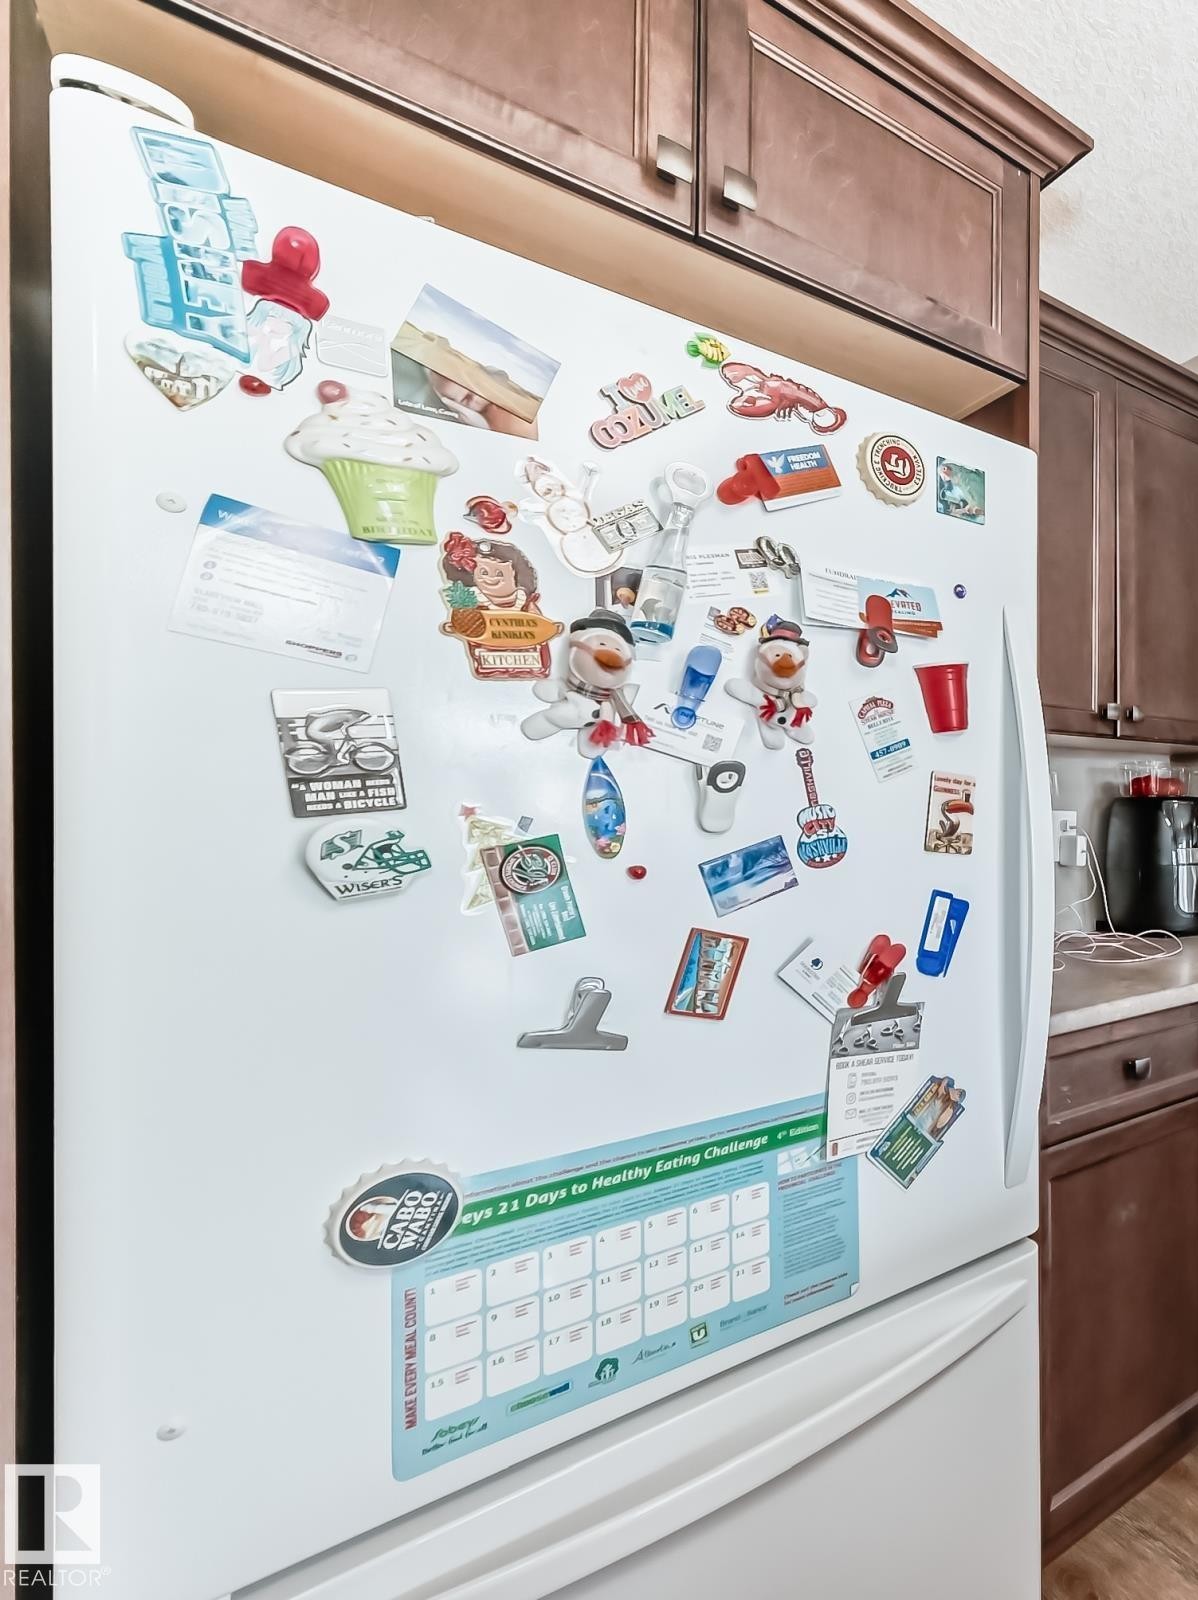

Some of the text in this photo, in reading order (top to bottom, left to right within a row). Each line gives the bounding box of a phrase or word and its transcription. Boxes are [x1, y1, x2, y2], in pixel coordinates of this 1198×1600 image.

[787, 451, 821, 464] FREEDOM
[790, 460, 818, 471] HEALTH
[890, 600, 922, 611] EVATED
[481, 653, 540, 667] KITCHEN
[309, 779, 362, 791] WOMAN
[305, 792, 336, 802] MAN
[368, 787, 396, 798] FISH
[343, 797, 397, 810] BICYCLE
[334, 876, 403, 895] WISER'S
[461, 1205, 492, 1225] eys
[497, 1199, 520, 1214] 21
[525, 1187, 567, 1208] Days
[571, 1180, 588, 1195] to
[592, 1161, 653, 1189] Healthy
[655, 1151, 702, 1174] Eating
[704, 1134, 769, 1161] Challenge
[789, 1123, 820, 1137] Edition
[383, 1190, 420, 1250] CABO
[397, 1191, 437, 1250] WABO
[404, 1329, 417, 1361] MEAL
[404, 1362, 417, 1397] EVERY
[404, 1397, 417, 1430] MAKE
